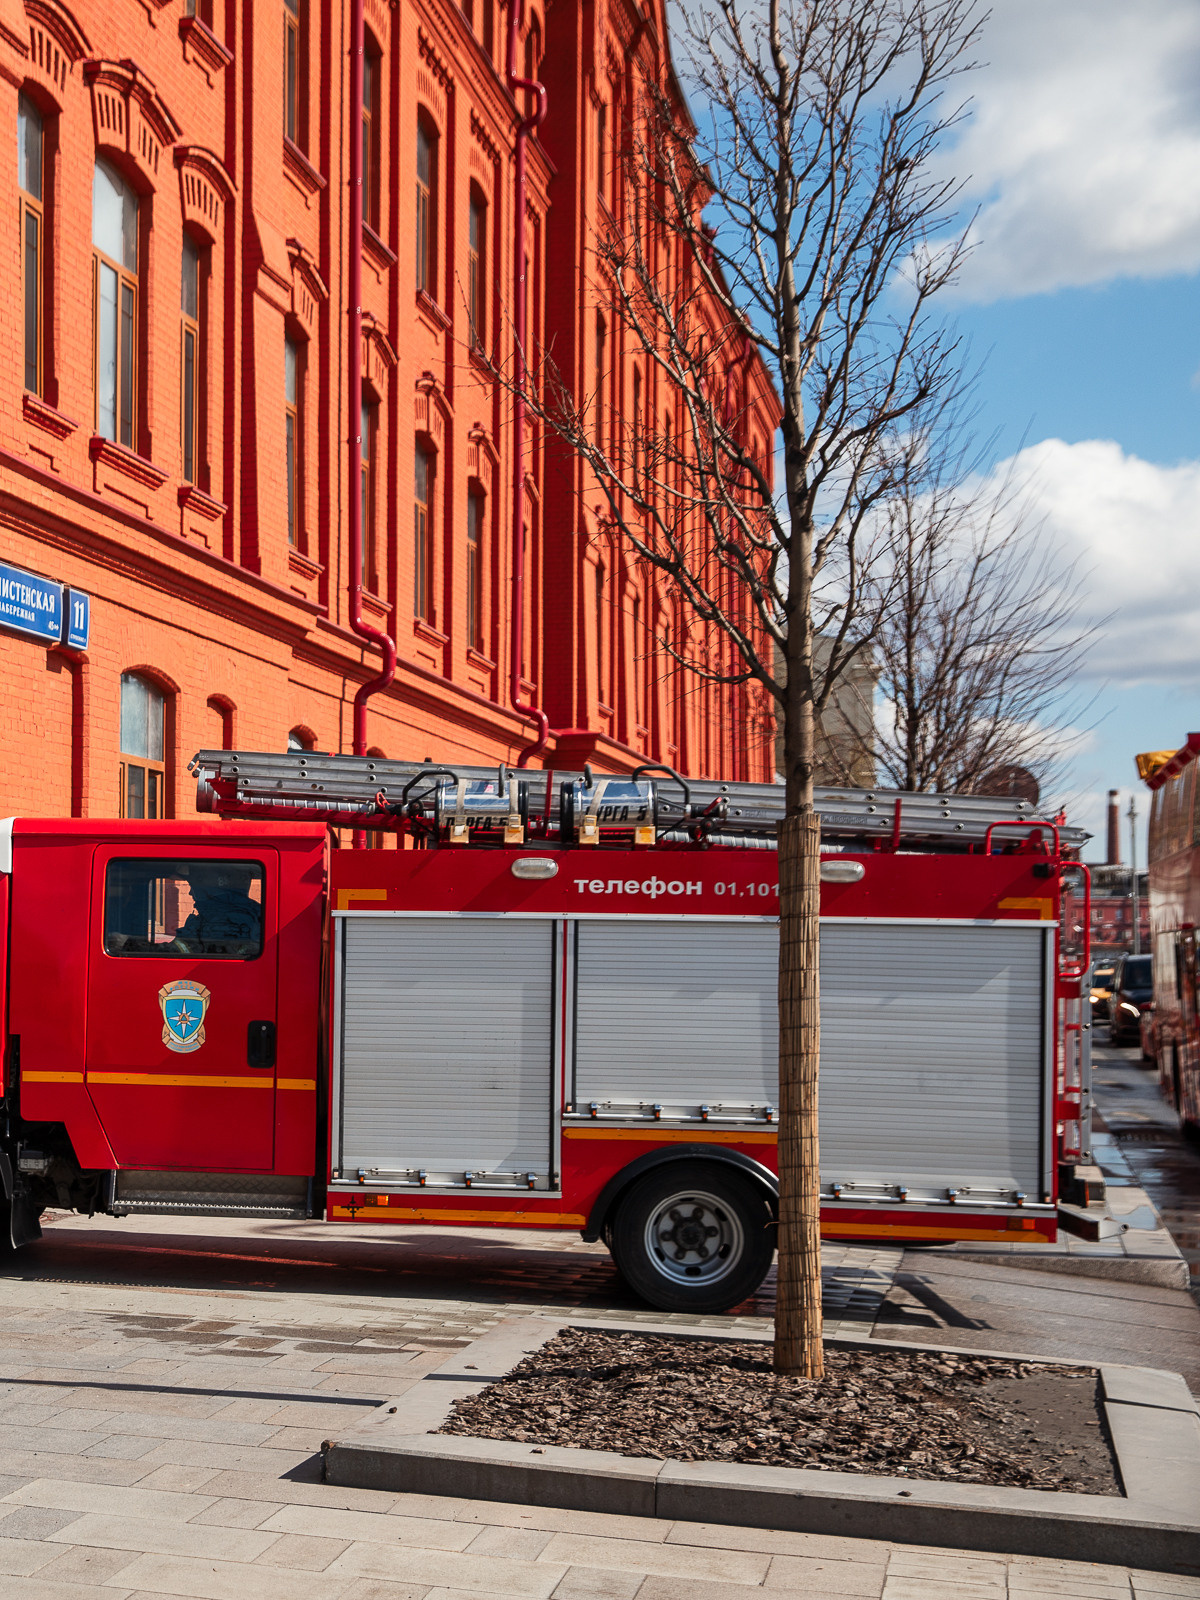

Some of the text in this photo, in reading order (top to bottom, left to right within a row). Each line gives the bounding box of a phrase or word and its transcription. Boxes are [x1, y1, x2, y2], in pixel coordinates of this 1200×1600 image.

[74, 600, 85, 630] 11
[637, 805, 648, 821] 5
[574, 876, 702, 899] телефон
